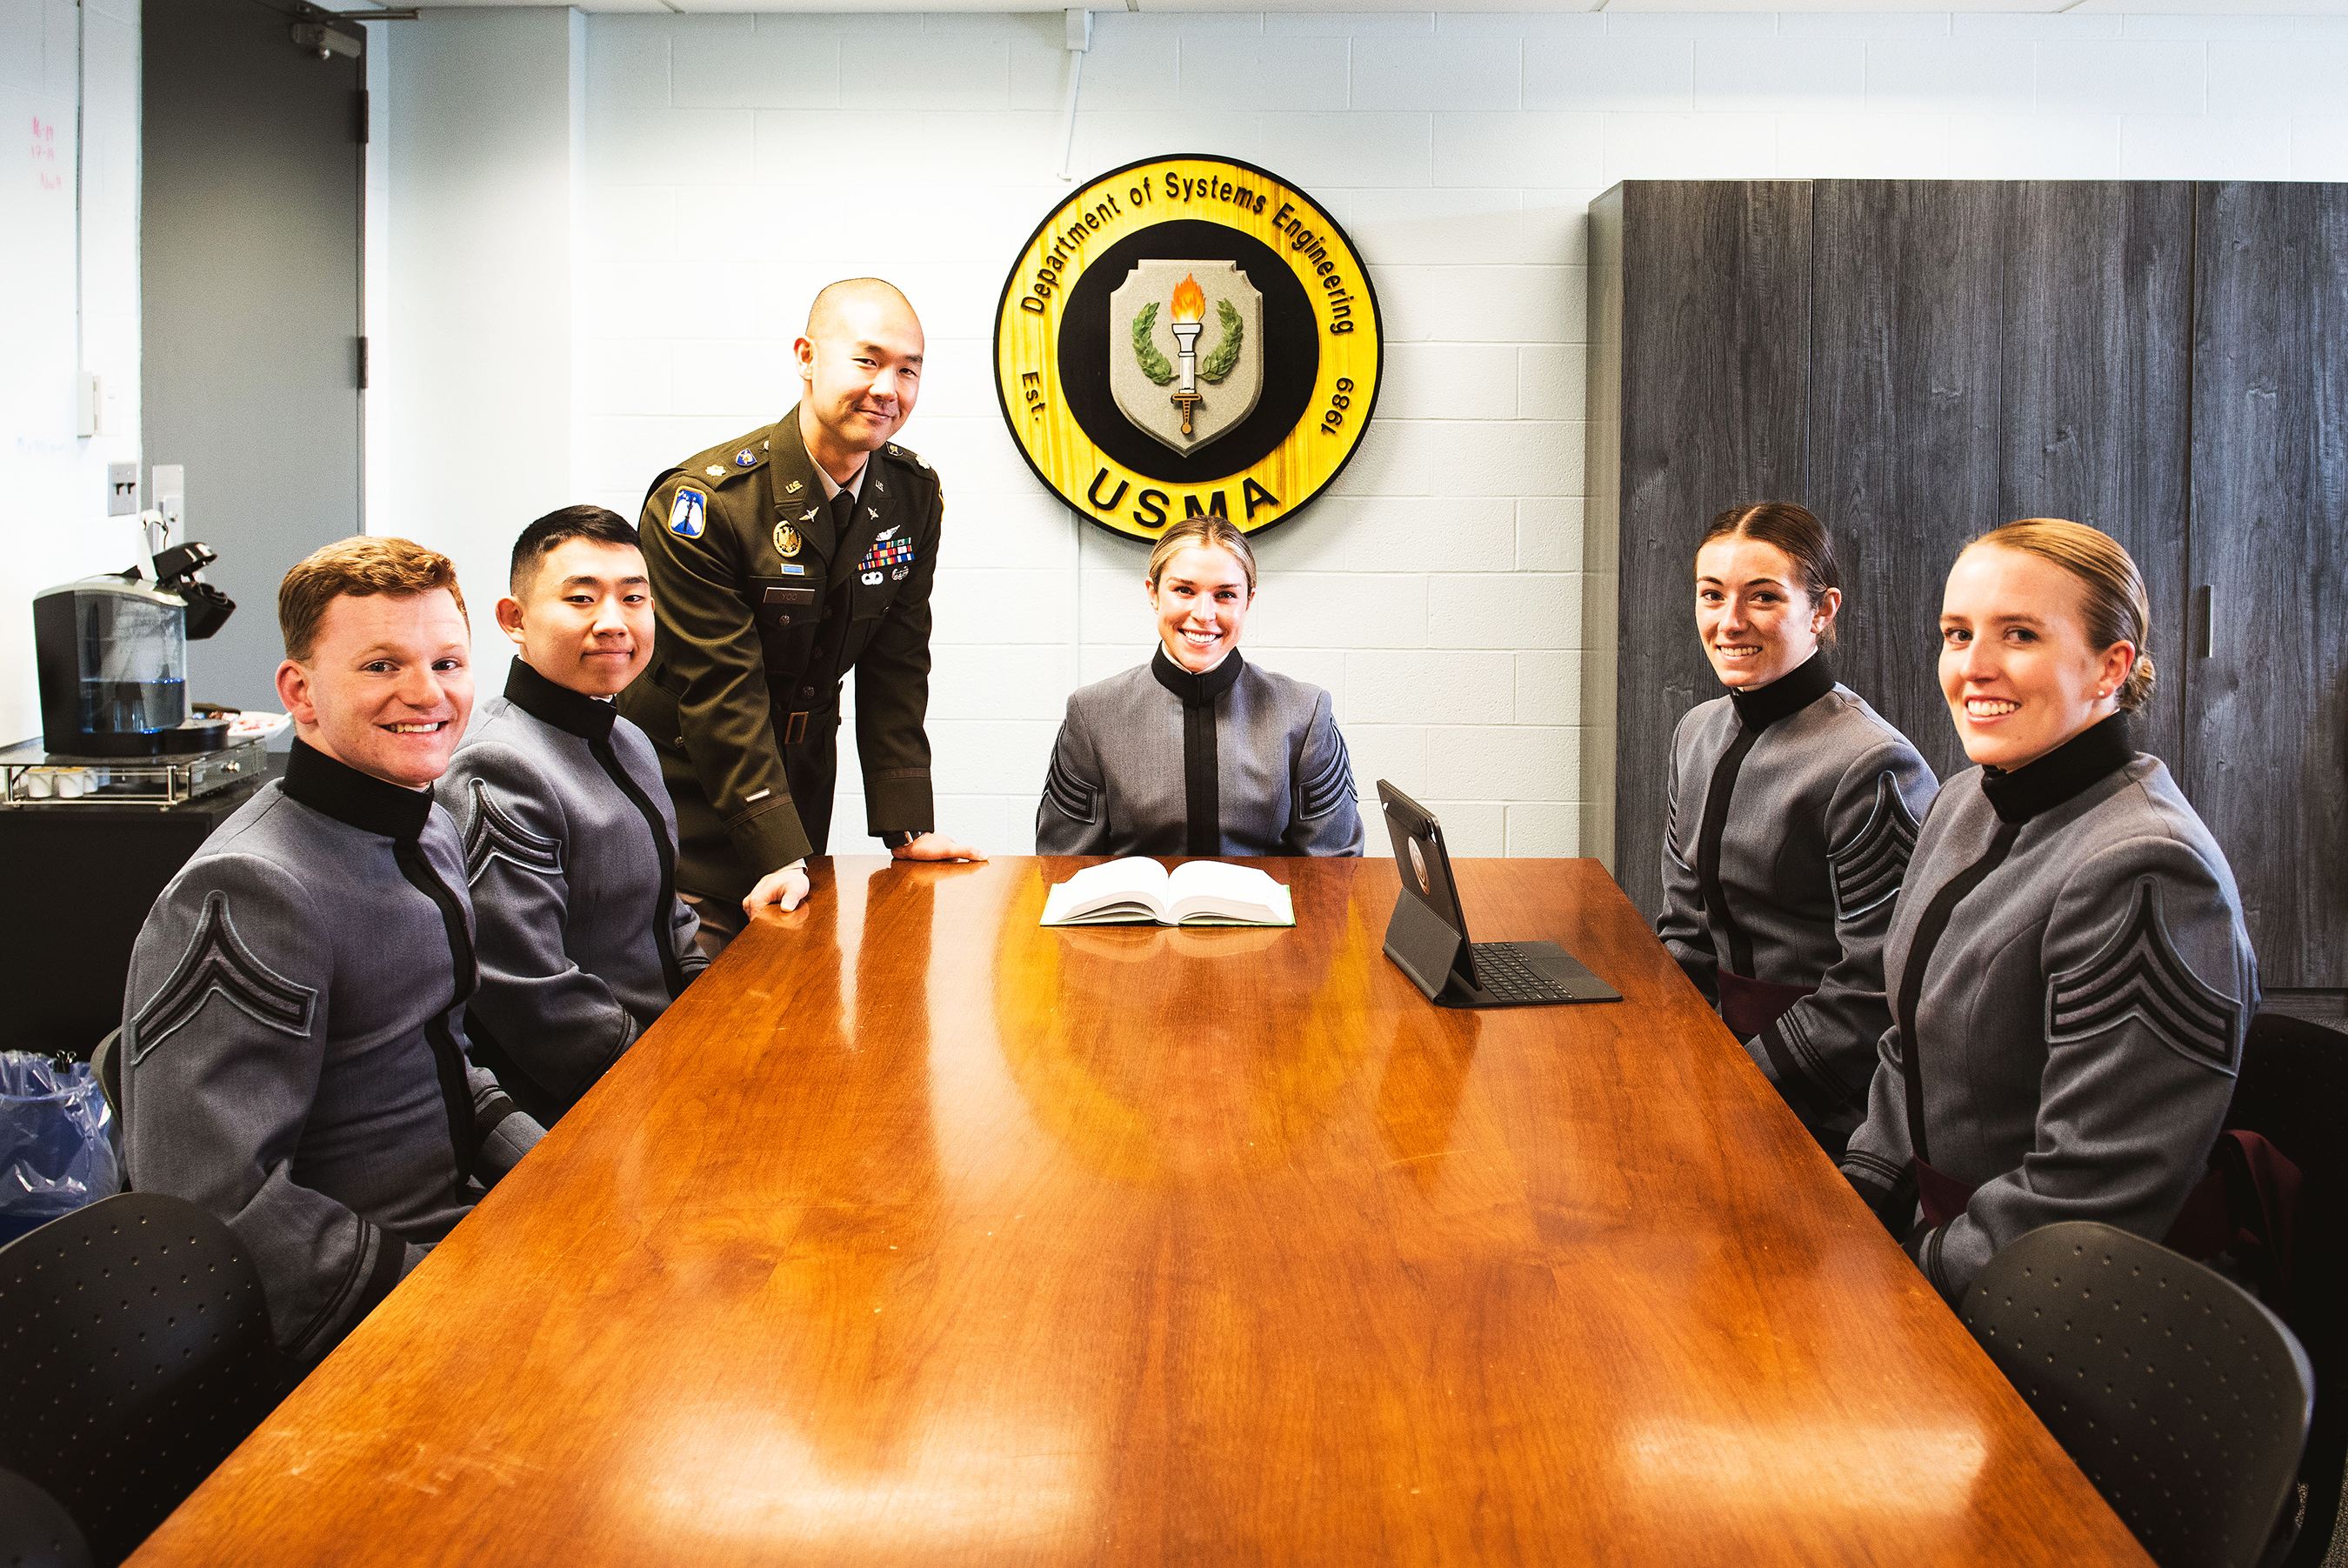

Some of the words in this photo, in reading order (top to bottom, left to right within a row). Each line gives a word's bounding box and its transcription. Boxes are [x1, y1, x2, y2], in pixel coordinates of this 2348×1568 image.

[1020, 193, 1122, 315] Department
[1130, 177, 1151, 206] of
[1165, 171, 1266, 214] Systems
[1271, 202, 1354, 335] Engineering
[1021, 371, 1046, 422] Est.
[1320, 377, 1355, 436] 1989
[1087, 467, 1279, 529] USMA
